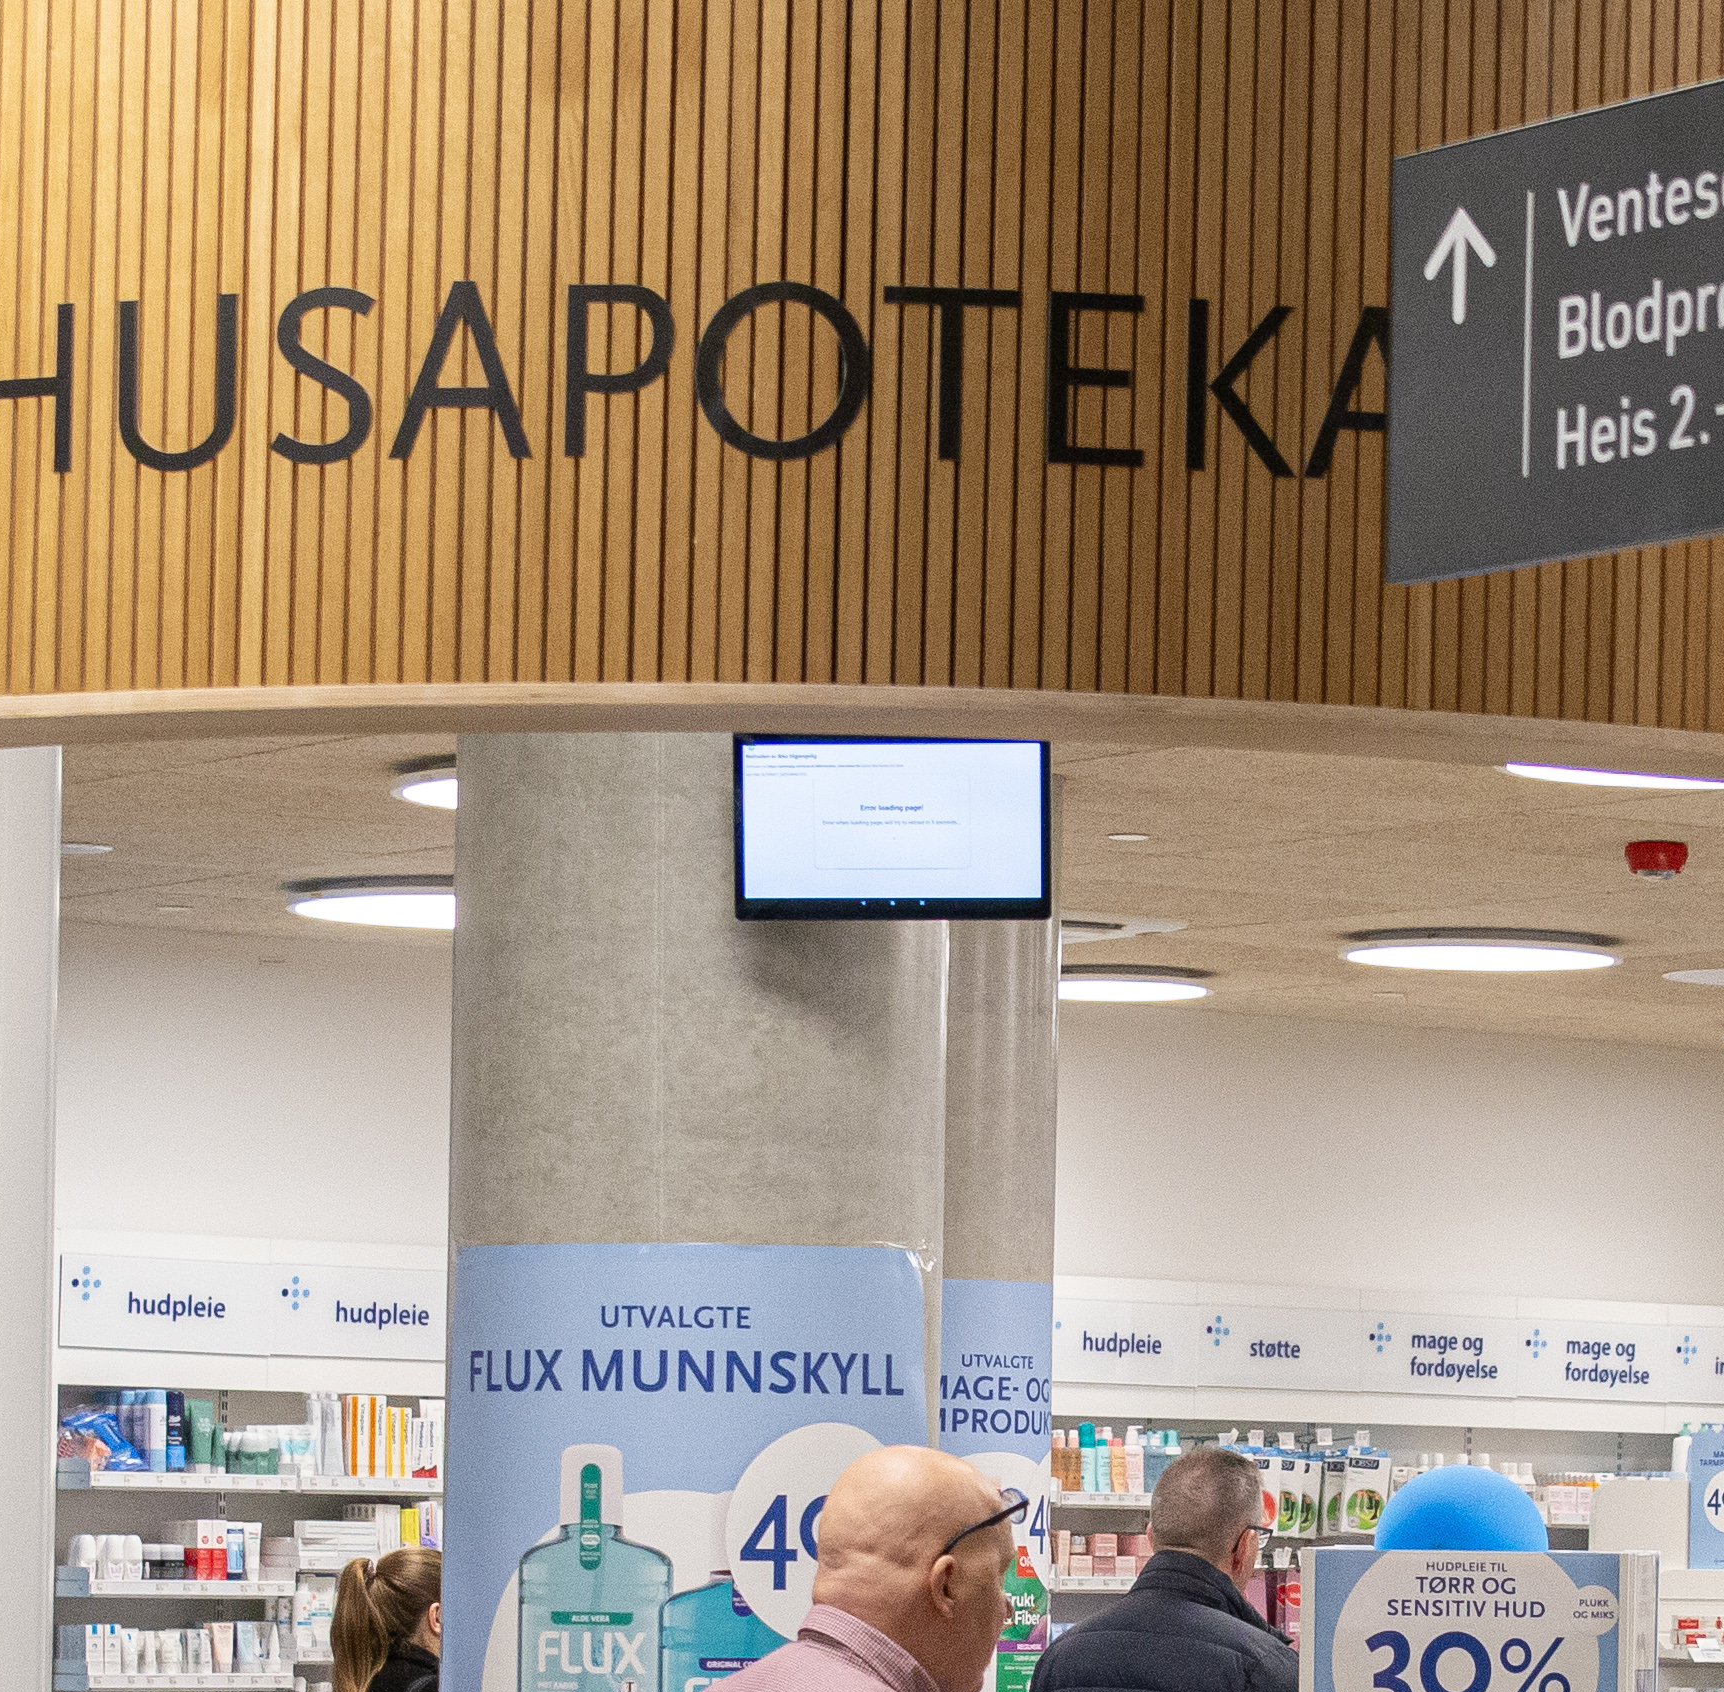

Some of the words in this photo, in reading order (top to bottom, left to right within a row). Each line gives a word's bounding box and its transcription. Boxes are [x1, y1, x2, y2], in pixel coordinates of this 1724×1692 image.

[1557, 397, 1657, 470] Heis
[128, 1291, 226, 1322] hudpleie
[335, 1300, 430, 1330] hudpleie
[600, 1305, 751, 1329] UTVALGTE
[1083, 1330, 1162, 1358] hudpleie
[1249, 1340, 1301, 1359] støtte
[1412, 1333, 1459, 1355] mage
[1462, 1335, 1483, 1355] og
[1566, 1339, 1611, 1361] mage
[1615, 1342, 1636, 1363] og
[469, 1348, 563, 1393] FLUX
[581, 1349, 905, 1397] MUNNSKYLL
[961, 1354, 1034, 1370] UTVALGTE
[1410, 1356, 1498, 1383] fordøyelse
[1565, 1364, 1650, 1389] fordøyelse
[1426, 1562, 1487, 1573] HUDPLEIE
[1490, 1562, 1508, 1573] TIL
[1416, 1576, 1475, 1594] TØRR
[1482, 1577, 1516, 1595] OG
[1387, 1599, 1486, 1618] SENSITIV
[1494, 1601, 1546, 1618] HUD
[1573, 1610, 1588, 1620] OG
[1591, 1610, 1615, 1620] MIKS
[1579, 1599, 1609, 1609] PLUKK
[537, 1630, 647, 1675] FLUX
